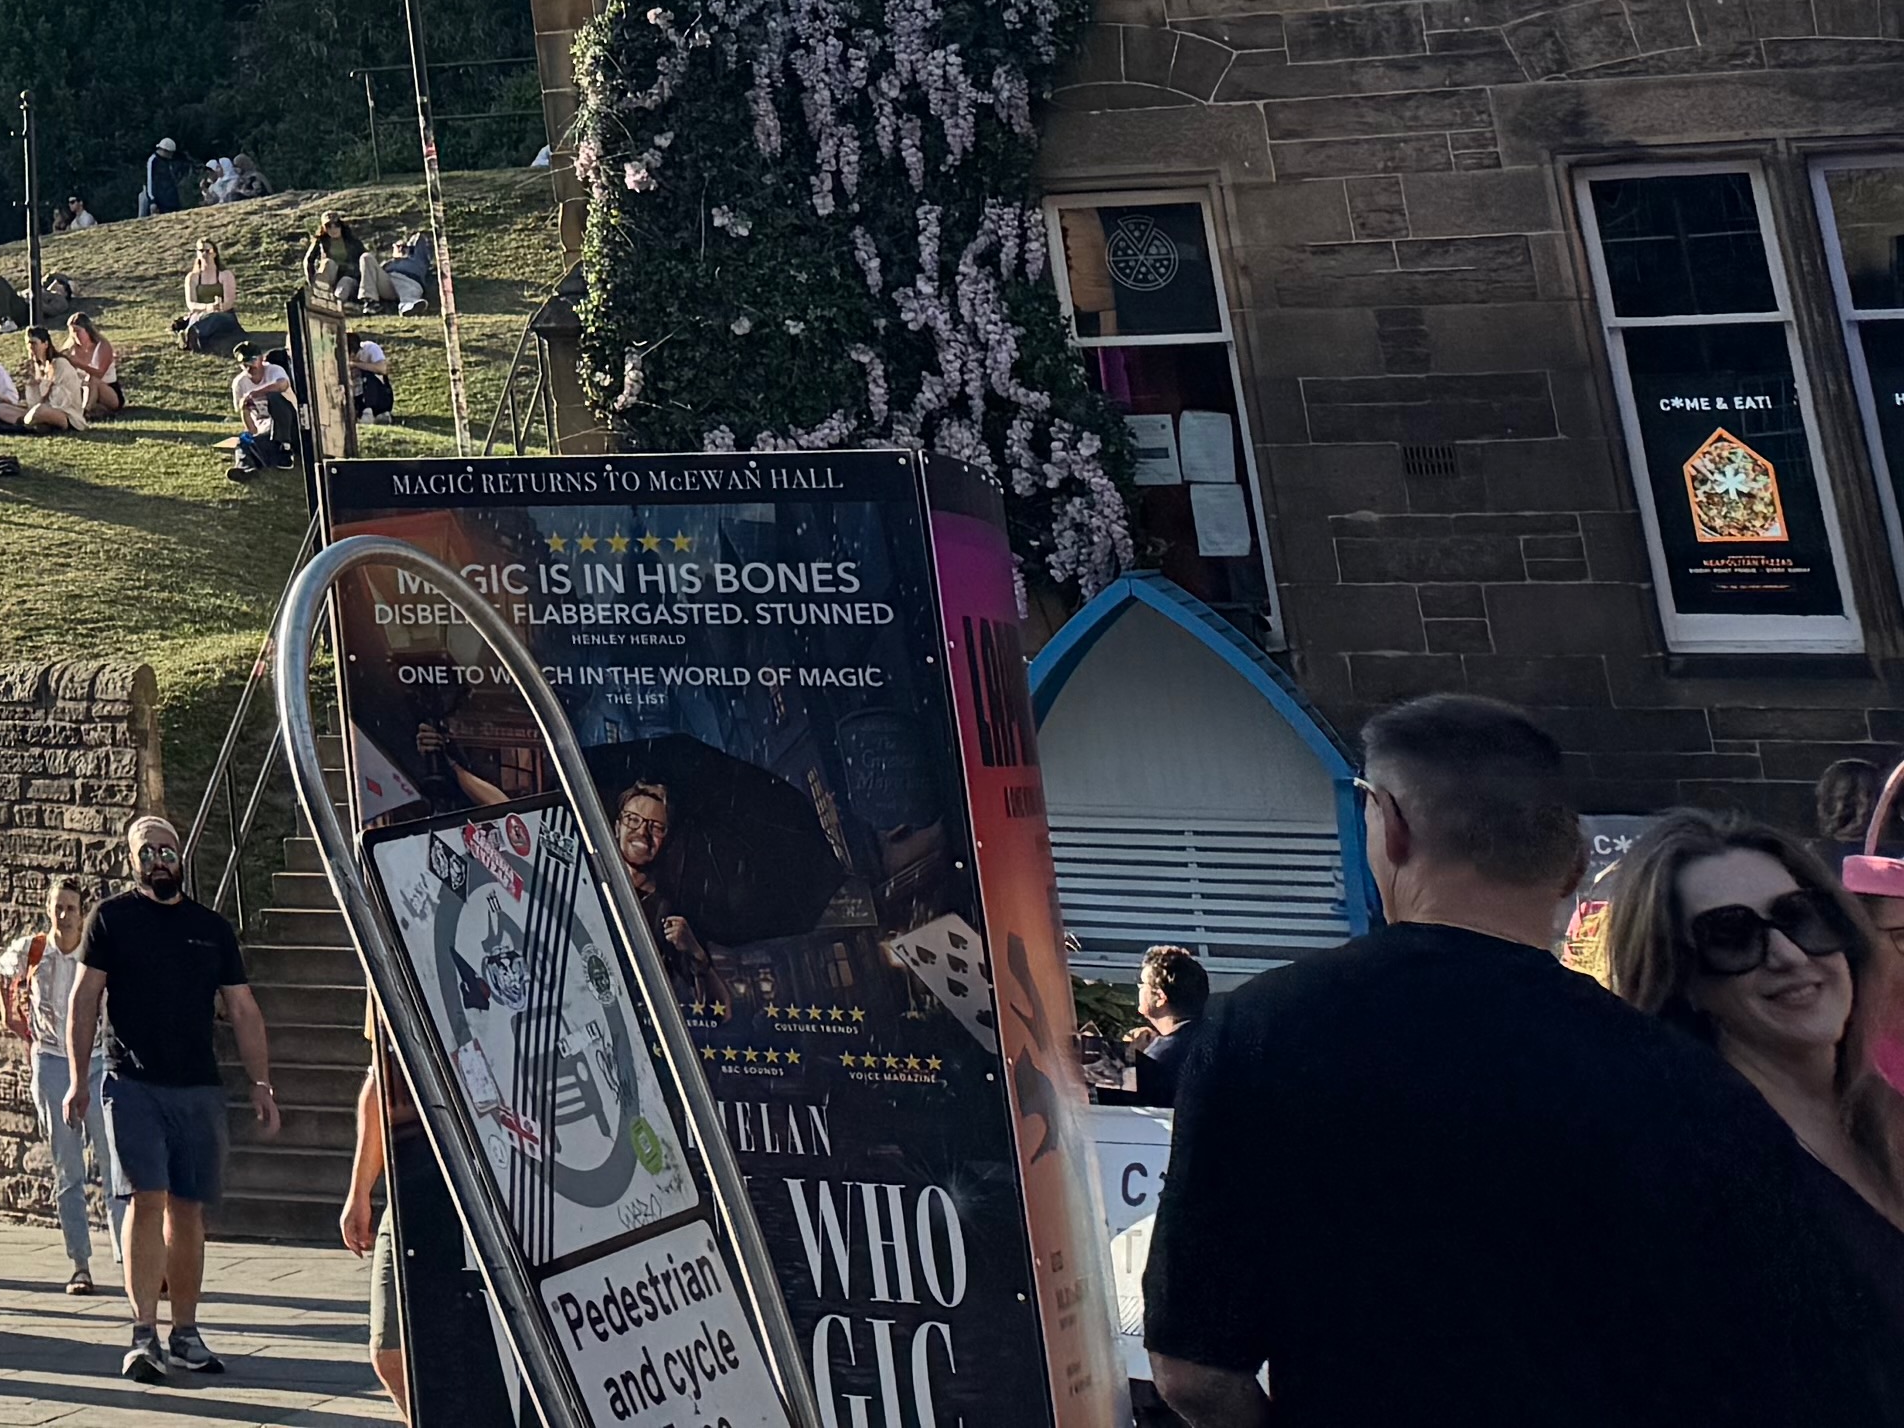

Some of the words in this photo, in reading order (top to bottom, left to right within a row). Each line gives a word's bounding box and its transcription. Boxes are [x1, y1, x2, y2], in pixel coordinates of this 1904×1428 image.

[1715, 397, 1729, 410] &
[1734, 395, 1772, 410] EAT!
[393, 473, 474, 495] MAGIC
[482, 471, 598, 493] RETURNS
[603, 471, 640, 492] TO
[649, 469, 762, 492] McEWAN
[770, 468, 845, 489] HALL
[397, 563, 529, 595] MGIC
[539, 564, 572, 595] IS
[583, 563, 626, 594] IN
[638, 562, 703, 594] HIS
[714, 562, 861, 593] BONES
[375, 604, 500, 624] DISBEL
[514, 603, 750, 625] FLABBERGASTED.
[756, 603, 894, 625] STUNNED
[572, 634, 625, 645] HENLEY
[630, 634, 686, 645] HERALD
[398, 665, 449, 684] ONE
[452, 665, 485, 684] TO
[490, 665, 579, 685] WCH
[580, 666, 604, 685] IN
[607, 666, 657, 685] THE
[659, 666, 752, 686] WORLD
[757, 666, 793, 687] OF
[799, 666, 885, 687] MAGIC
[606, 693, 633, 704] THE
[637, 693, 666, 704] LIST
[774, 1023, 818, 1033] CULTURE
[820, 1024, 859, 1034] TRENDS
[744, 1066, 784, 1077] SOUNDS
[849, 1071, 880, 1082] VOICE
[784, 1178, 967, 1308] WHO
[560, 1251, 723, 1351] Pedestrian
[603, 1346, 667, 1421] and
[664, 1320, 740, 1401] cycle
[813, 1314, 963, 1428] GIC
